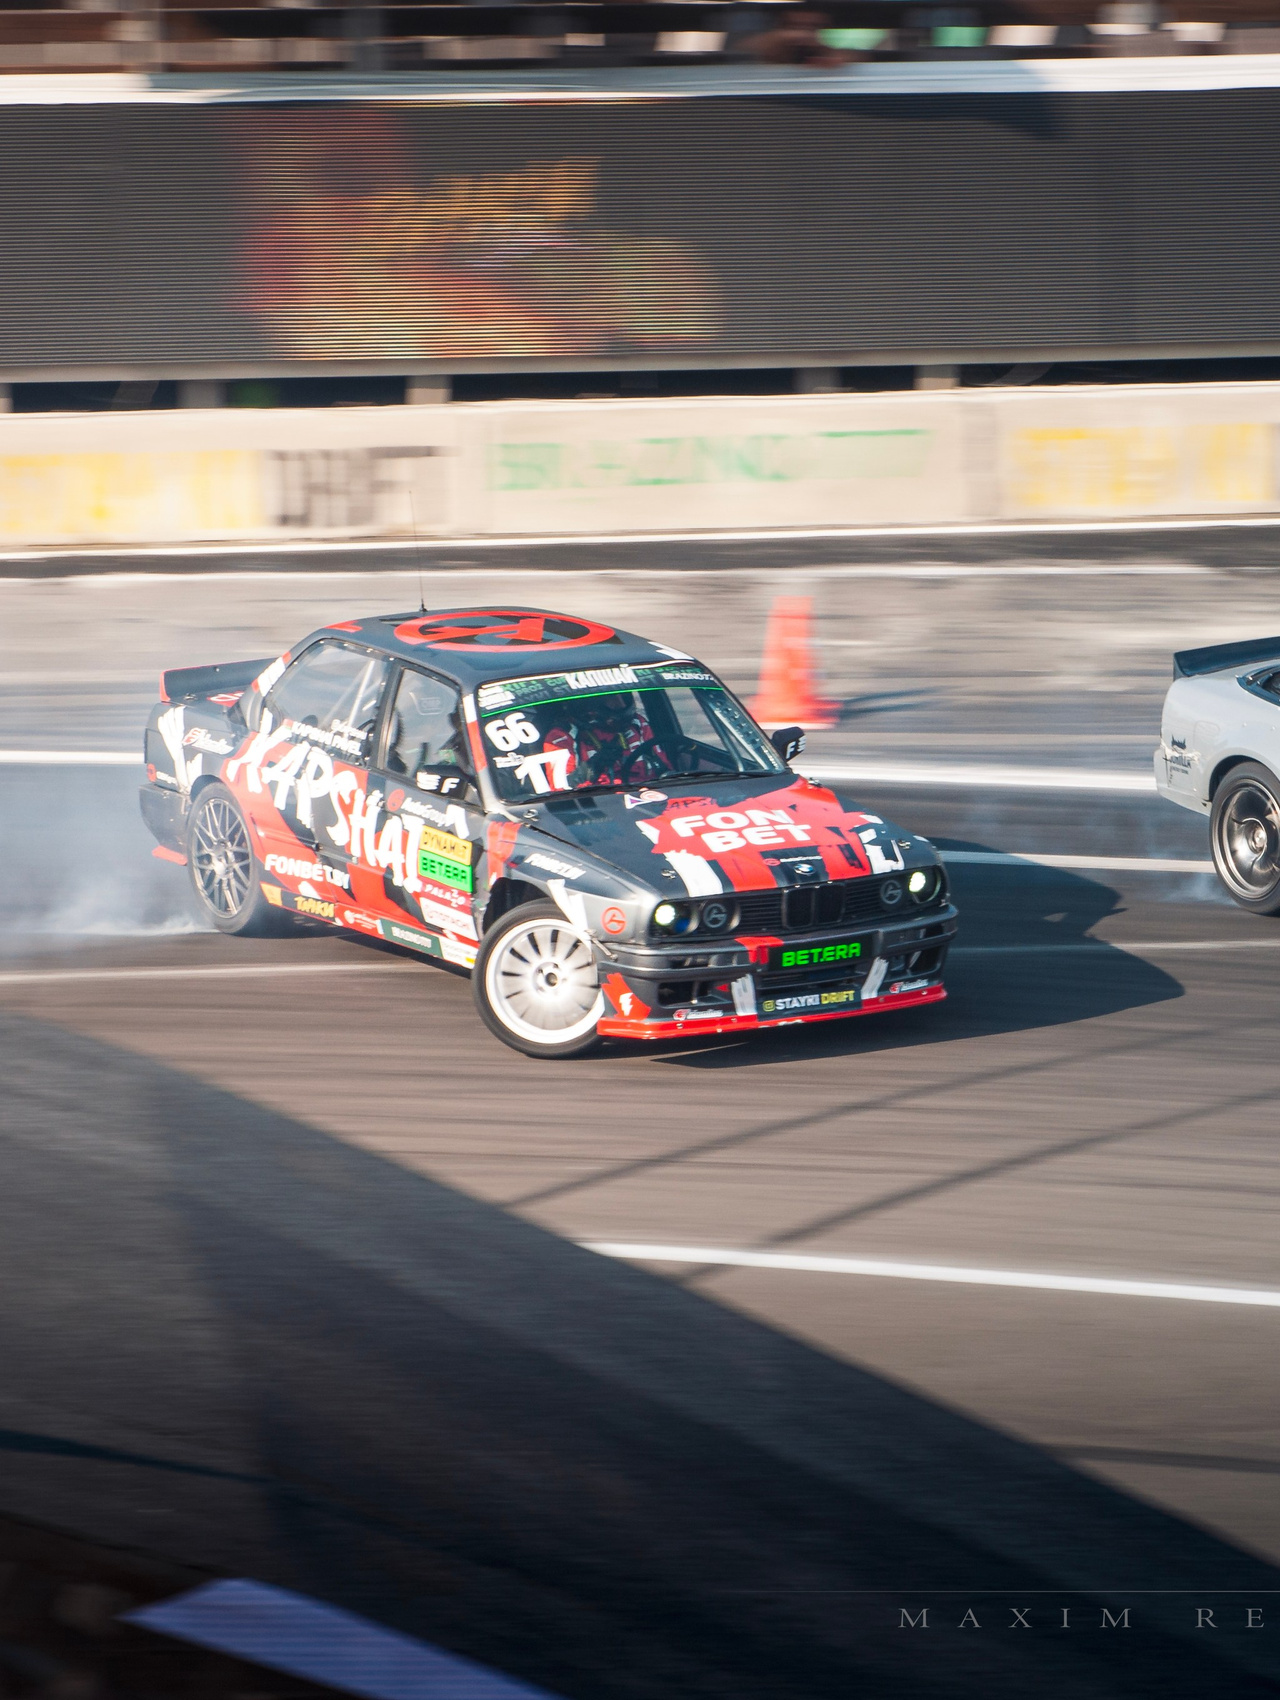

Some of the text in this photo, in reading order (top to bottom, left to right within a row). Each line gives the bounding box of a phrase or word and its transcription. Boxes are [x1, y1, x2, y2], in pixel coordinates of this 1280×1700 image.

[564, 663, 639, 690] КАПШАЙ
[485, 711, 541, 752] 66
[514, 748, 573, 795] 17
[670, 809, 795, 838] FON
[700, 824, 812, 853] BET
[820, 989, 856, 1005] DRIFT
